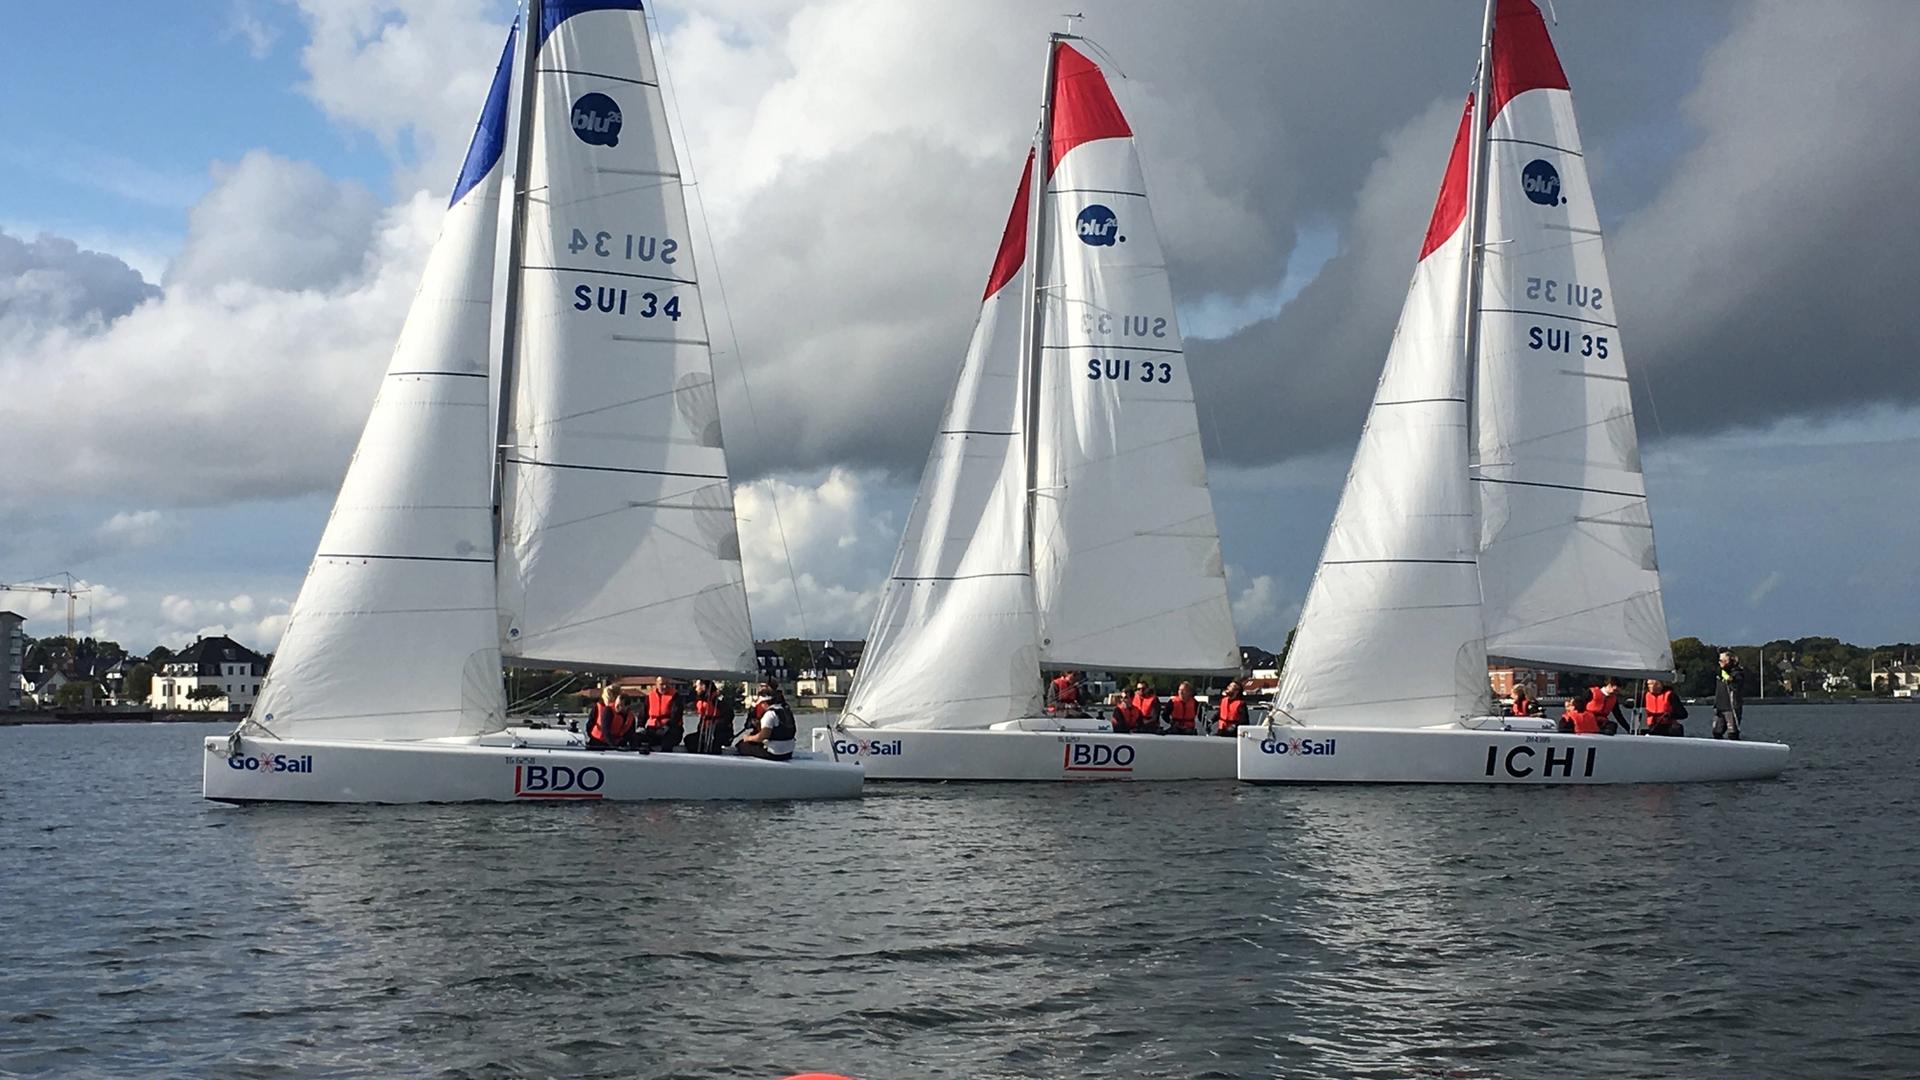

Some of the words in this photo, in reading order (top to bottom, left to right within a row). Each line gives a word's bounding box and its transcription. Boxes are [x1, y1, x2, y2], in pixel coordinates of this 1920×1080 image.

[573, 284, 628, 315] SUI
[640, 292, 682, 322] 34
[1528, 326, 1570, 353] SUI
[1580, 334, 1609, 360] 35
[1087, 359, 1130, 381] SUI
[1140, 361, 1172, 384] 33
[833, 739, 859, 755] Go
[870, 740, 902, 756] Sail
[1073, 743, 1135, 766] BDO
[1260, 738, 1289, 755] Go
[1301, 738, 1336, 756] Sail
[228, 752, 260, 771] Go
[273, 754, 313, 774] Sail
[1485, 745, 1597, 778] ICHI
[526, 765, 605, 791] BDO
